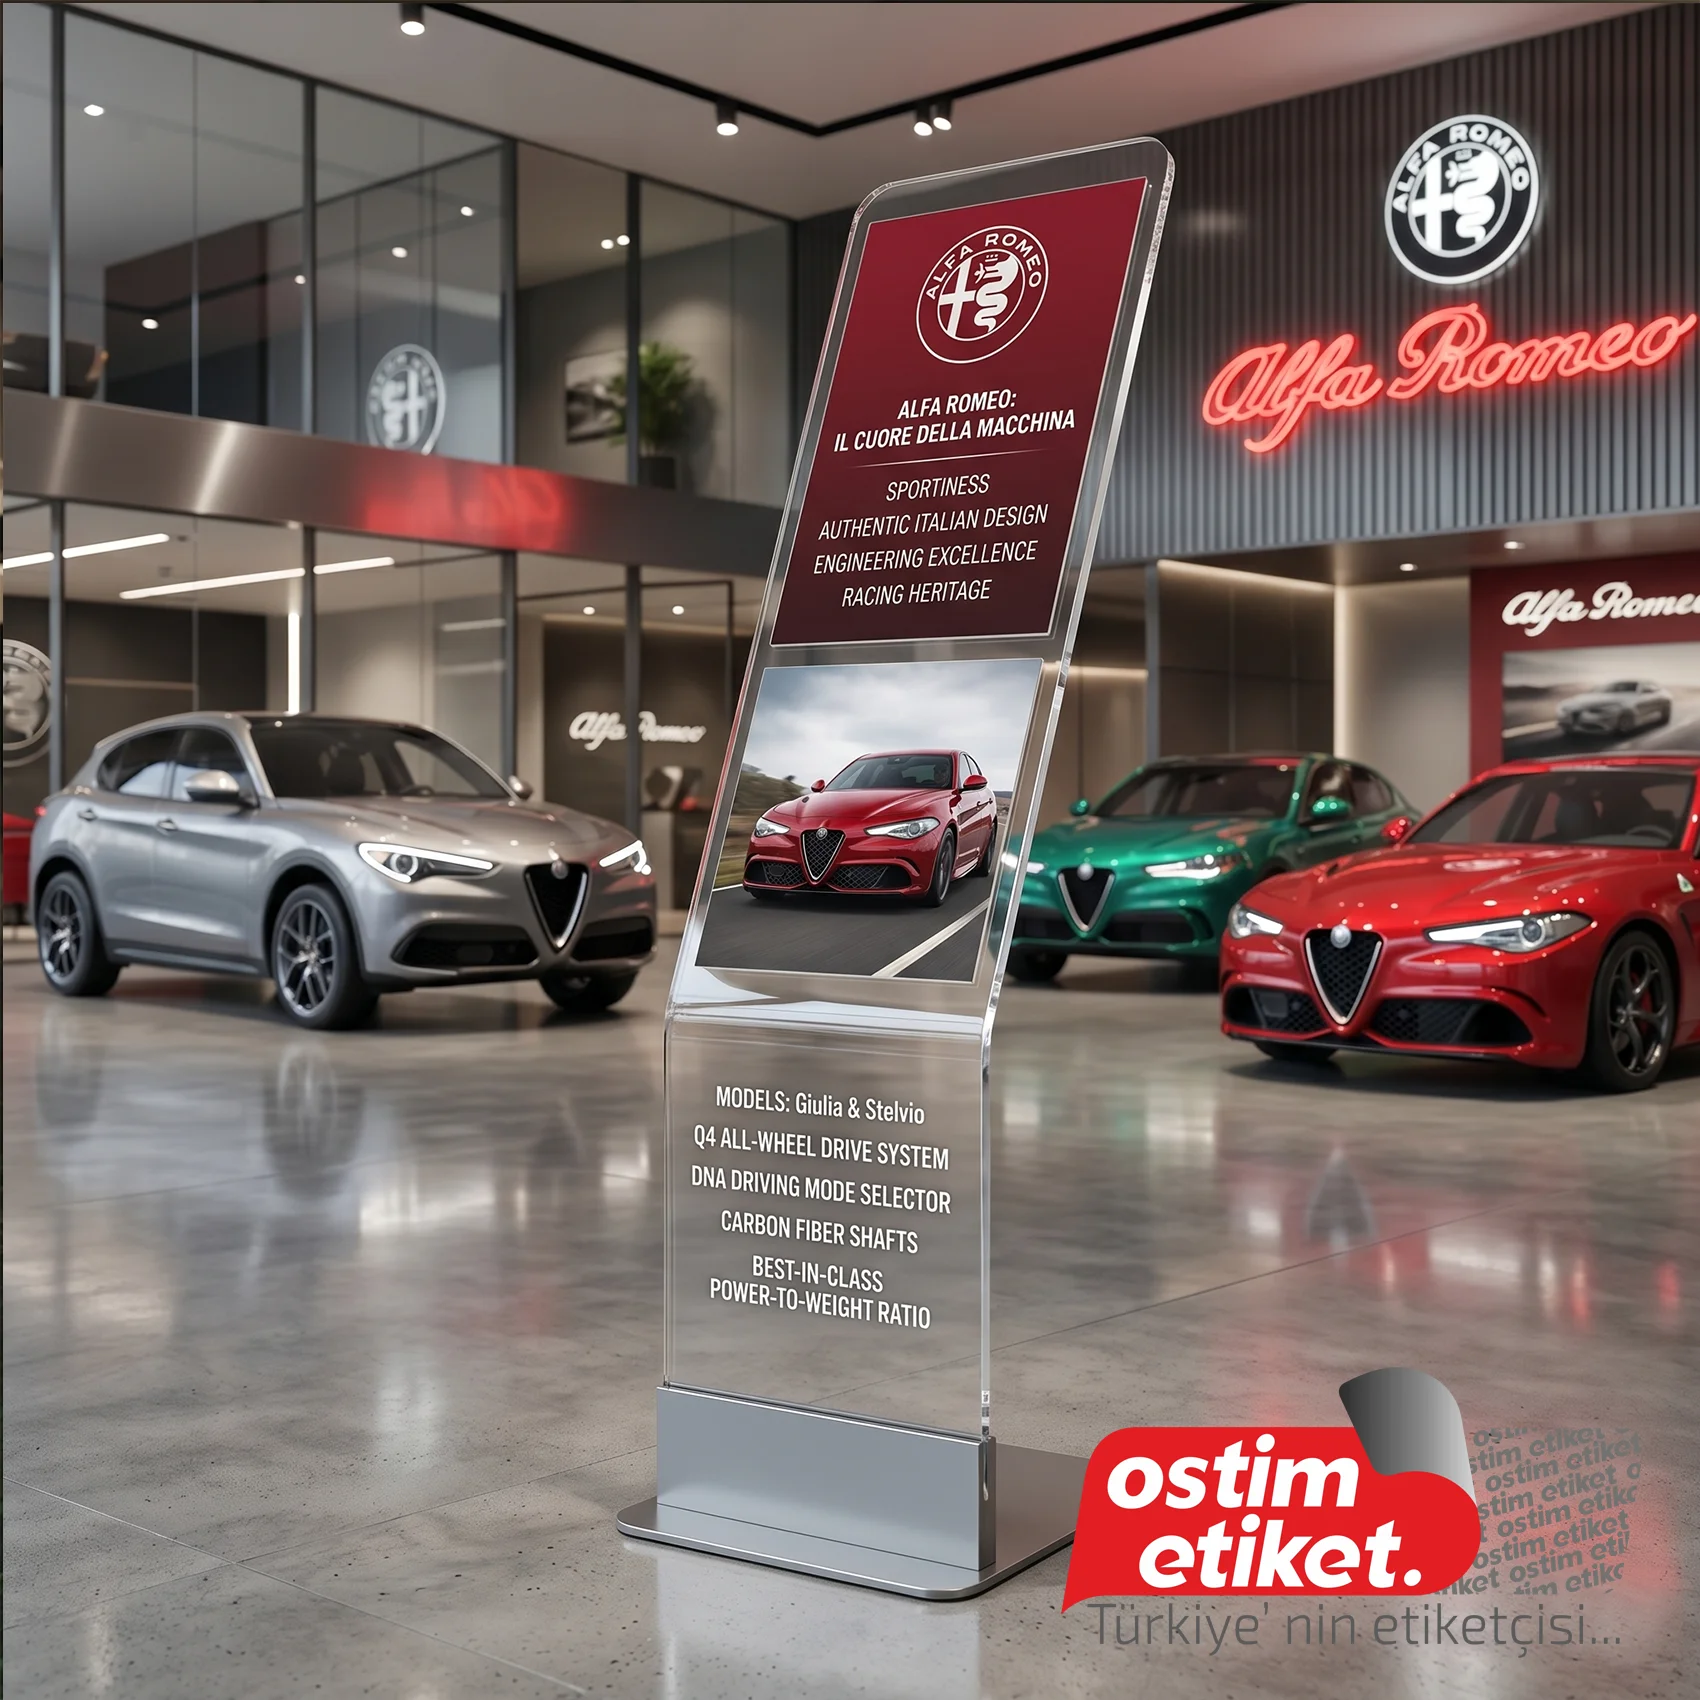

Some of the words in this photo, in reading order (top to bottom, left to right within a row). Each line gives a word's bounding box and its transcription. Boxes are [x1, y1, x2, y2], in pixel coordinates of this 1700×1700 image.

[1392, 140, 1440, 213] ALFA
[1449, 123, 1530, 192] ROMEO
[926, 245, 973, 300] ALFA
[985, 233, 1042, 288] ROMEO
[1202, 333, 1383, 453] Alfa
[1386, 302, 1698, 400] Romeo
[897, 394, 941, 420] ALFA
[946, 389, 1017, 413] ROMEO:
[834, 433, 849, 452] IL
[854, 423, 911, 451] CUORE
[916, 416, 971, 444] DELLA
[977, 409, 1075, 437] MACCHINA
[886, 473, 990, 501] SPORTINESS
[818, 513, 910, 541] AUTHENTIC
[914, 508, 979, 533] ITALIAN
[984, 504, 1048, 528] DESIGN
[814, 548, 923, 575] ENGINEERING
[928, 540, 1038, 568] EXCELLENCE
[842, 585, 903, 607] RACING
[908, 579, 992, 604] HERITAGE
[1502, 588, 1589, 637] Alfa
[569, 711, 628, 751] Alfa
[716, 1085, 790, 1112] MODELS:
[795, 1092, 843, 1117] Giulia
[848, 1097, 860, 1119] &
[865, 1098, 925, 1125] Stelvio
[694, 1124, 716, 1149] Q4
[720, 1128, 816, 1157] ALL-WHEEL
[821, 1136, 872, 1163] DRIVE
[877, 1142, 949, 1170] SYSTEM
[692, 1165, 726, 1189] DNA
[731, 1169, 800, 1197] DRIVING
[805, 1177, 855, 1203] MODE
[860, 1183, 951, 1214] SELECTOR
[721, 1210, 790, 1238] CARBON
[796, 1218, 844, 1245] FIBER
[849, 1225, 918, 1254] SHAFTS
[753, 1255, 883, 1293] BEST-IN-CLASS
[710, 1278, 873, 1321] POWER-TO-WEIGHT
[878, 1301, 931, 1329] RATIO
